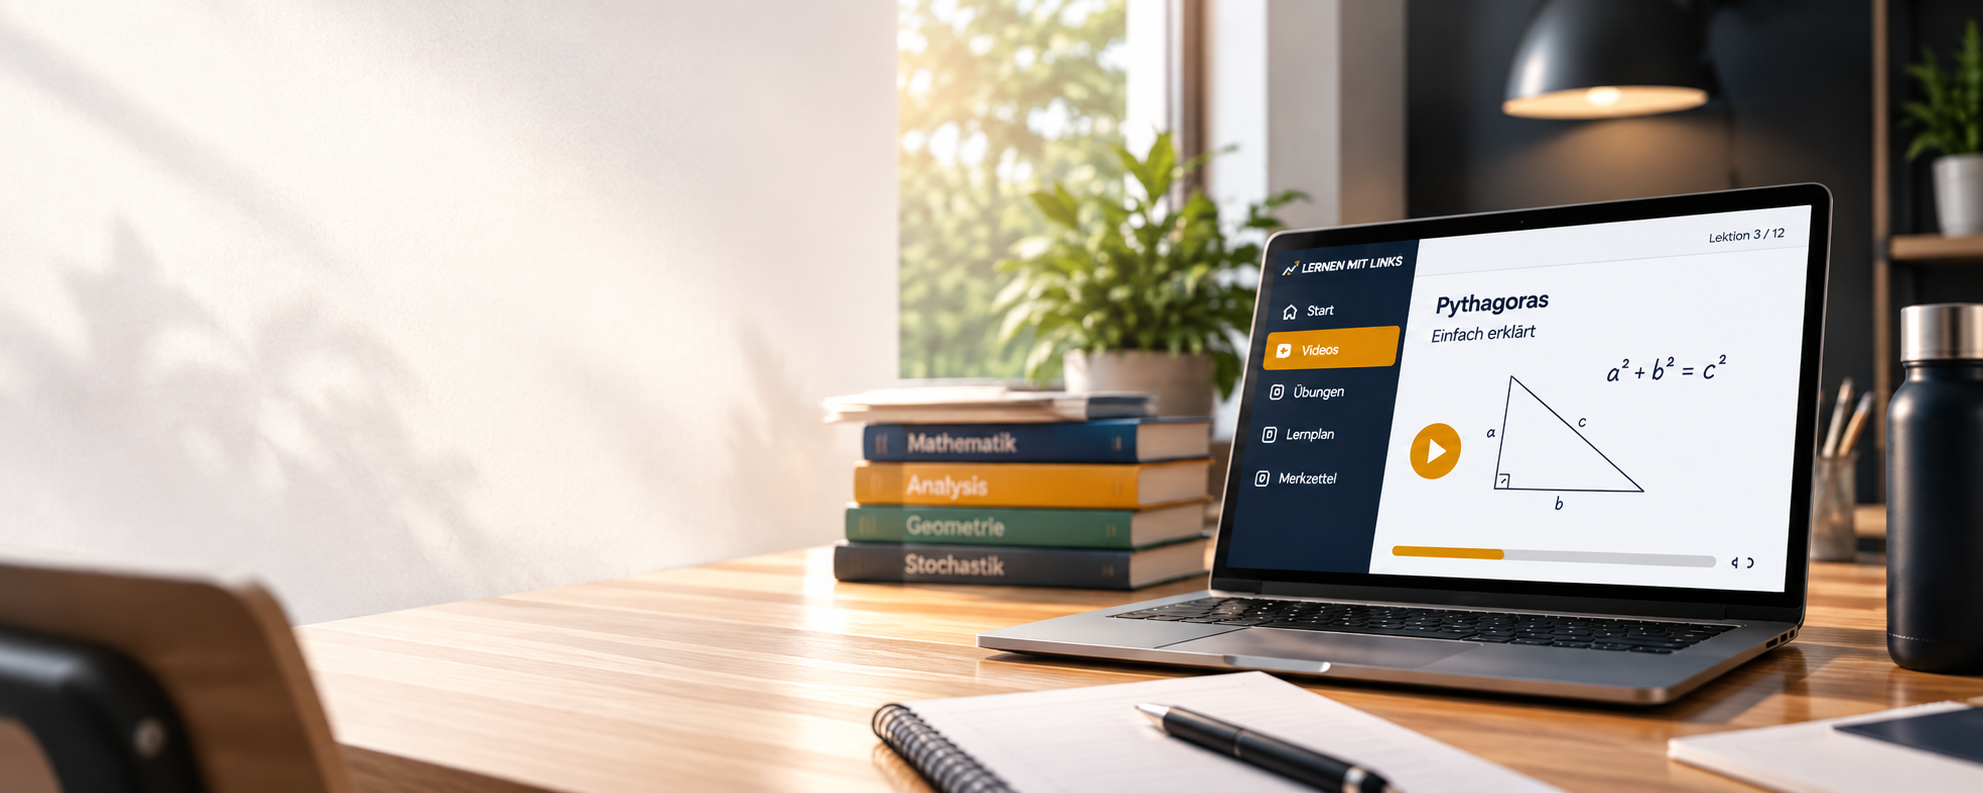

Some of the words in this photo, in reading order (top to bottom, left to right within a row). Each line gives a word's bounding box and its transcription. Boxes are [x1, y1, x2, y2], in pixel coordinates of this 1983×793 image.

[1709, 230, 1751, 244] Lektion
[1753, 228, 1762, 240] 3
[1773, 227, 1786, 239] 12
[1302, 261, 1345, 273] LERNEN
[1347, 259, 1368, 269] MIT
[1370, 257, 1403, 269] LINKS
[1308, 305, 1334, 316] Start
[1436, 294, 1549, 317] Pythagoras
[1432, 327, 1483, 343] Einfach
[1488, 325, 1536, 339] erklärt
[1303, 345, 1338, 355] Videos
[1294, 384, 1344, 400] Übungen
[1579, 418, 1586, 427] c
[1287, 428, 1334, 442] Lernplan
[1487, 429, 1495, 438] a
[906, 432, 1017, 454] Mathematik
[1279, 472, 1337, 484] Merkzettel
[906, 474, 989, 500] Analysis
[1555, 496, 1563, 510] b
[906, 515, 1006, 538] Geometrie
[905, 554, 1005, 577] Stochastik
